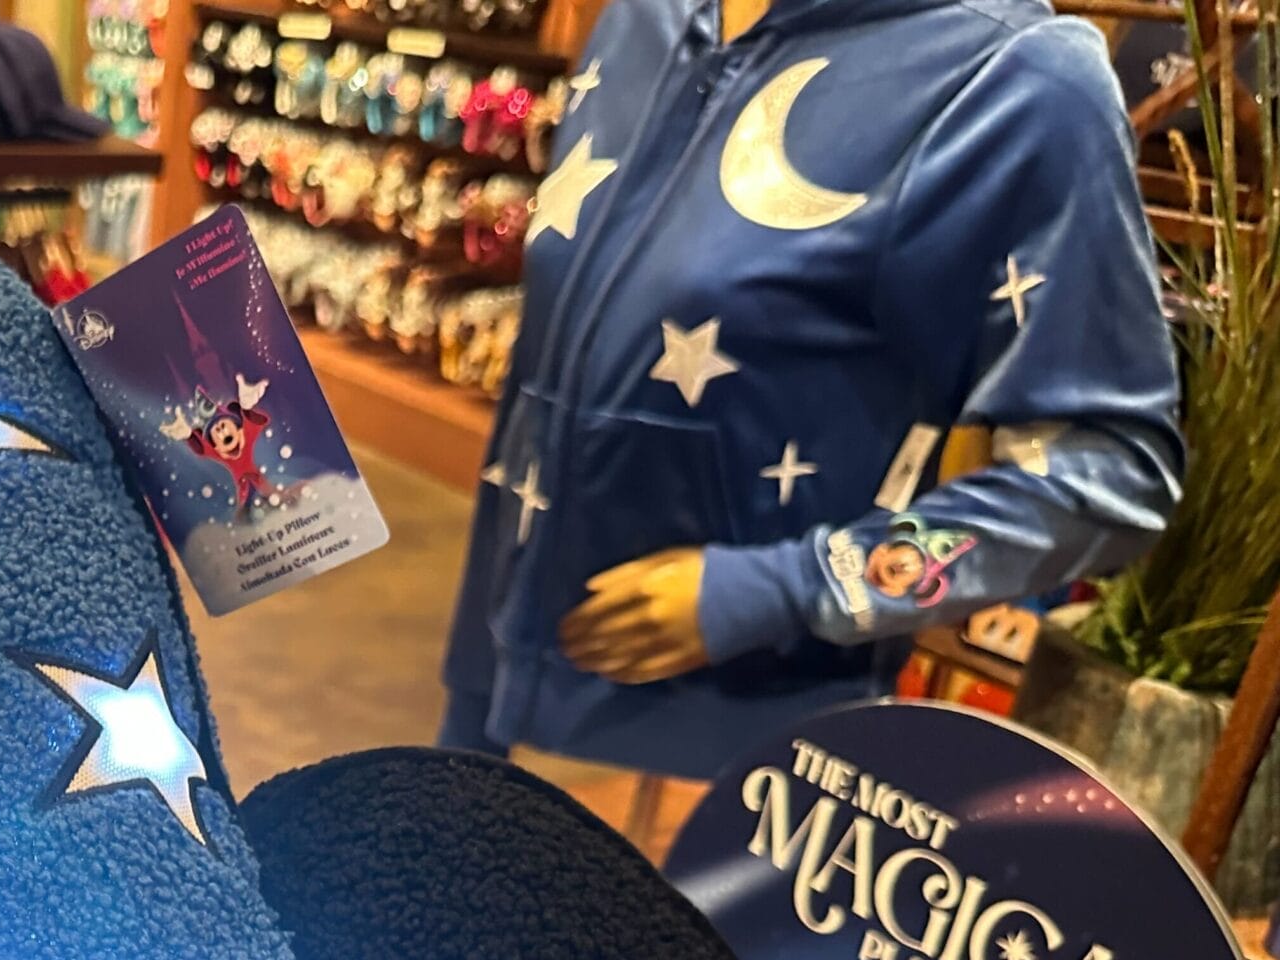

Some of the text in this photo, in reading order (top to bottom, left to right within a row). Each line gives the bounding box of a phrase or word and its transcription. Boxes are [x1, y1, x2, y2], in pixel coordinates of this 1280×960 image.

[283, 511, 321, 534] Pillow
[292, 552, 317, 569] Con
[791, 738, 961, 850] THE MOST
